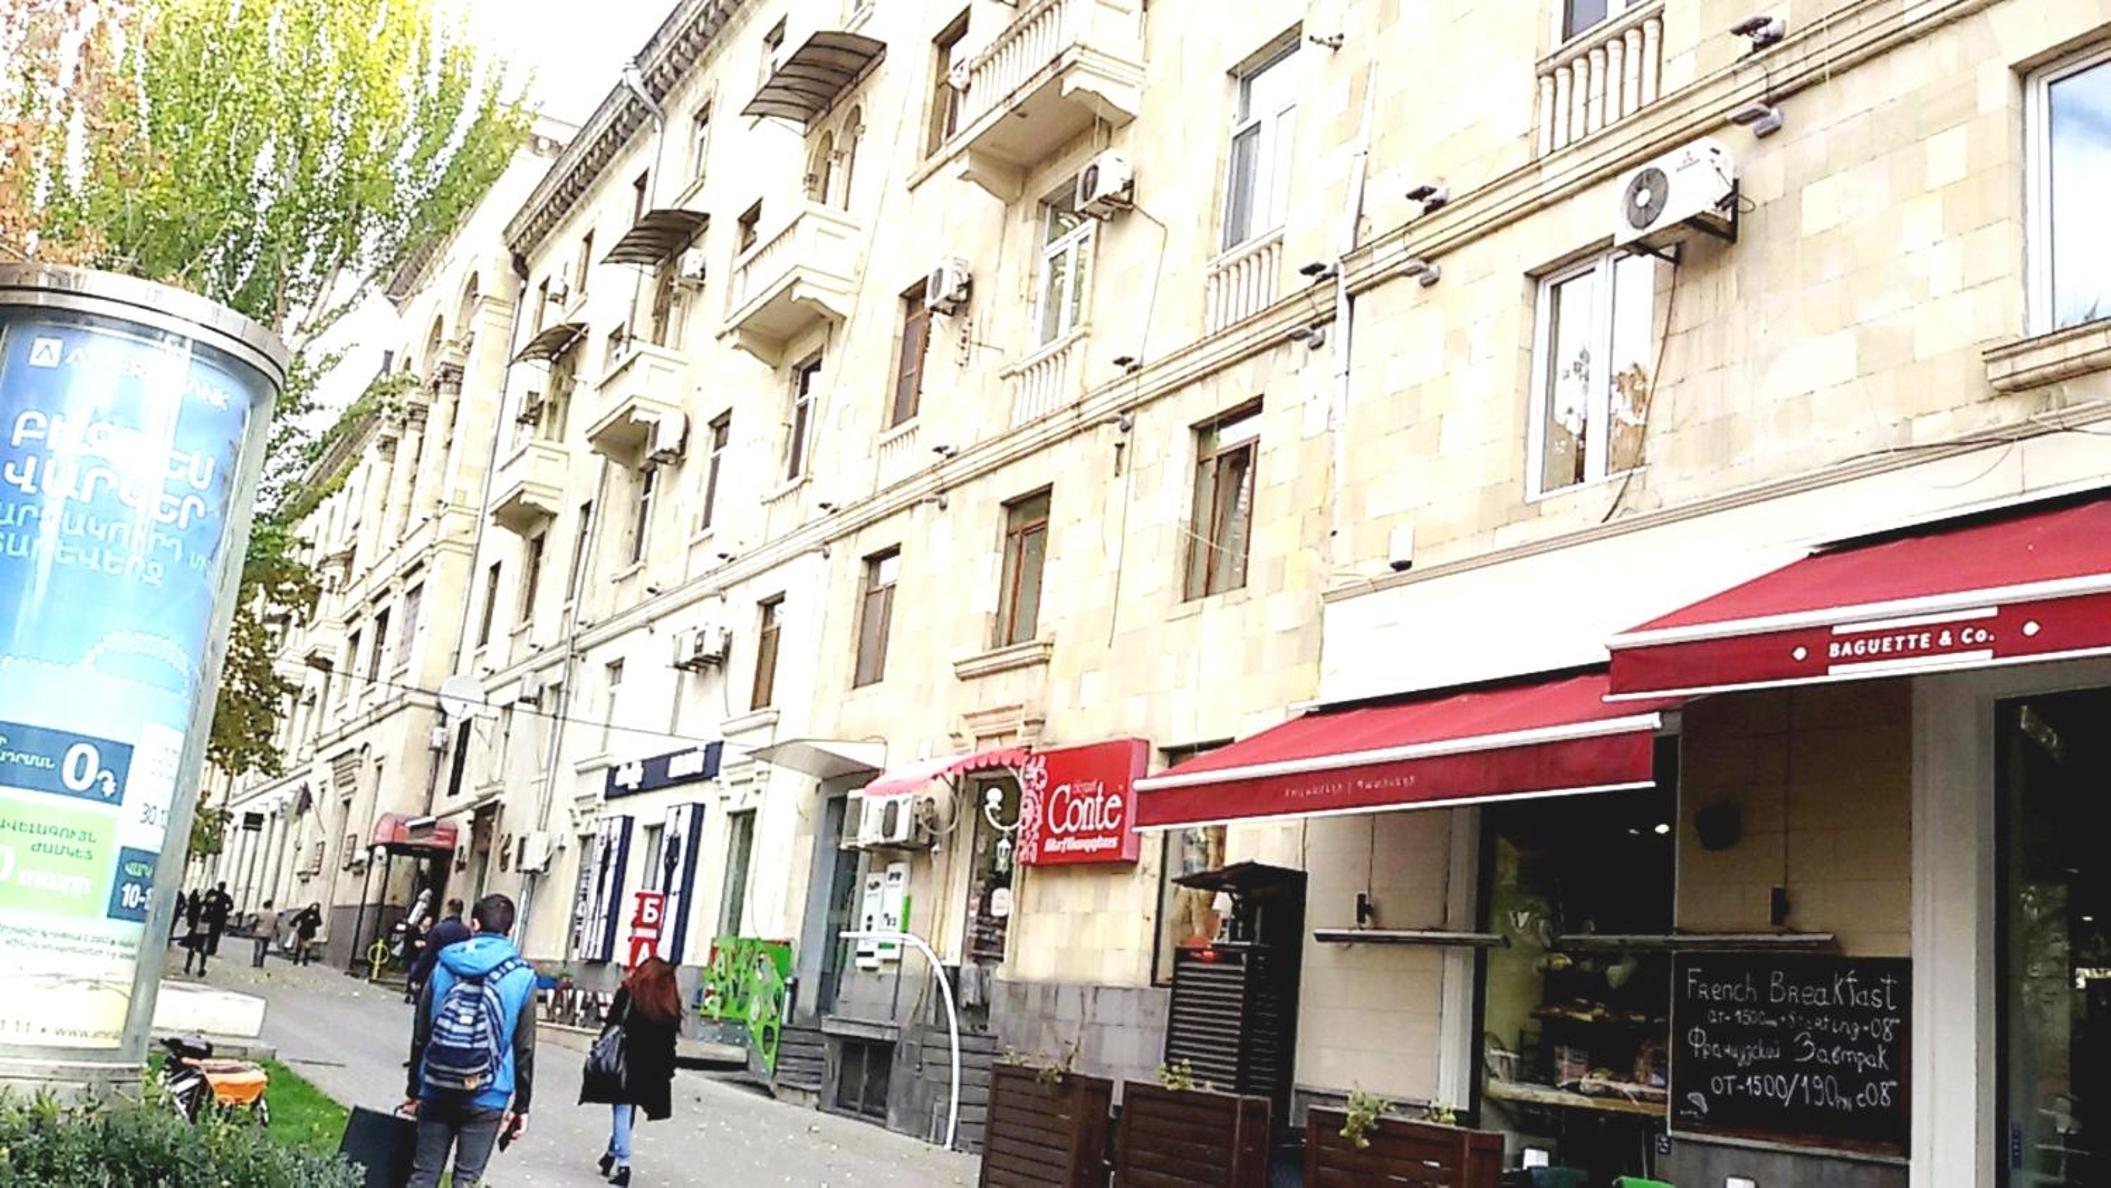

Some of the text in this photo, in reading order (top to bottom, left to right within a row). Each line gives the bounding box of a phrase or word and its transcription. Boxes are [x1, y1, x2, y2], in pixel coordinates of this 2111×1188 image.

[1828, 632, 1932, 658] BAGUETTE
[1938, 629, 1952, 646] &
[1048, 780, 1123, 834] Conte
